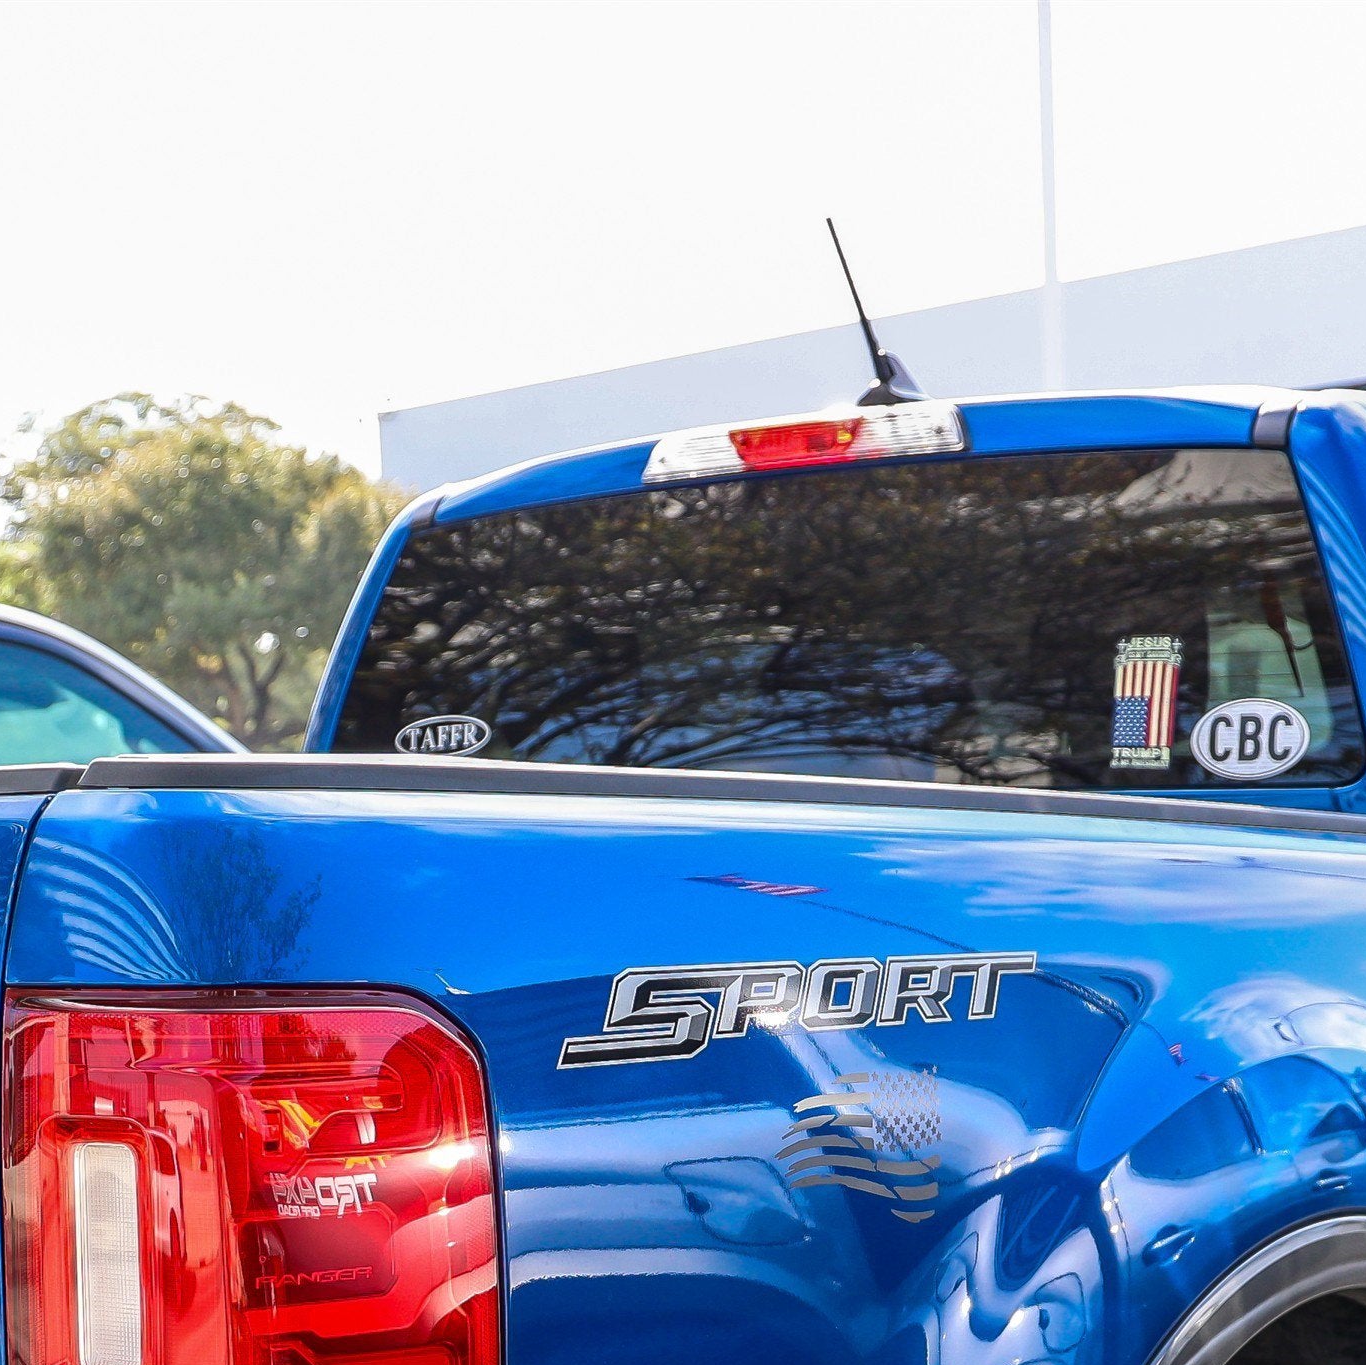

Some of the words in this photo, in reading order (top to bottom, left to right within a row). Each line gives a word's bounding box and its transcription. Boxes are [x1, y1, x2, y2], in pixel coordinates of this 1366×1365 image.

[1127, 636, 1172, 648] JESUS
[1209, 713, 1295, 763] CBC
[1111, 747, 1162, 760] TRUMP
[556, 951, 1037, 1070] SPORT
[255, 1266, 373, 1290] RANGER
